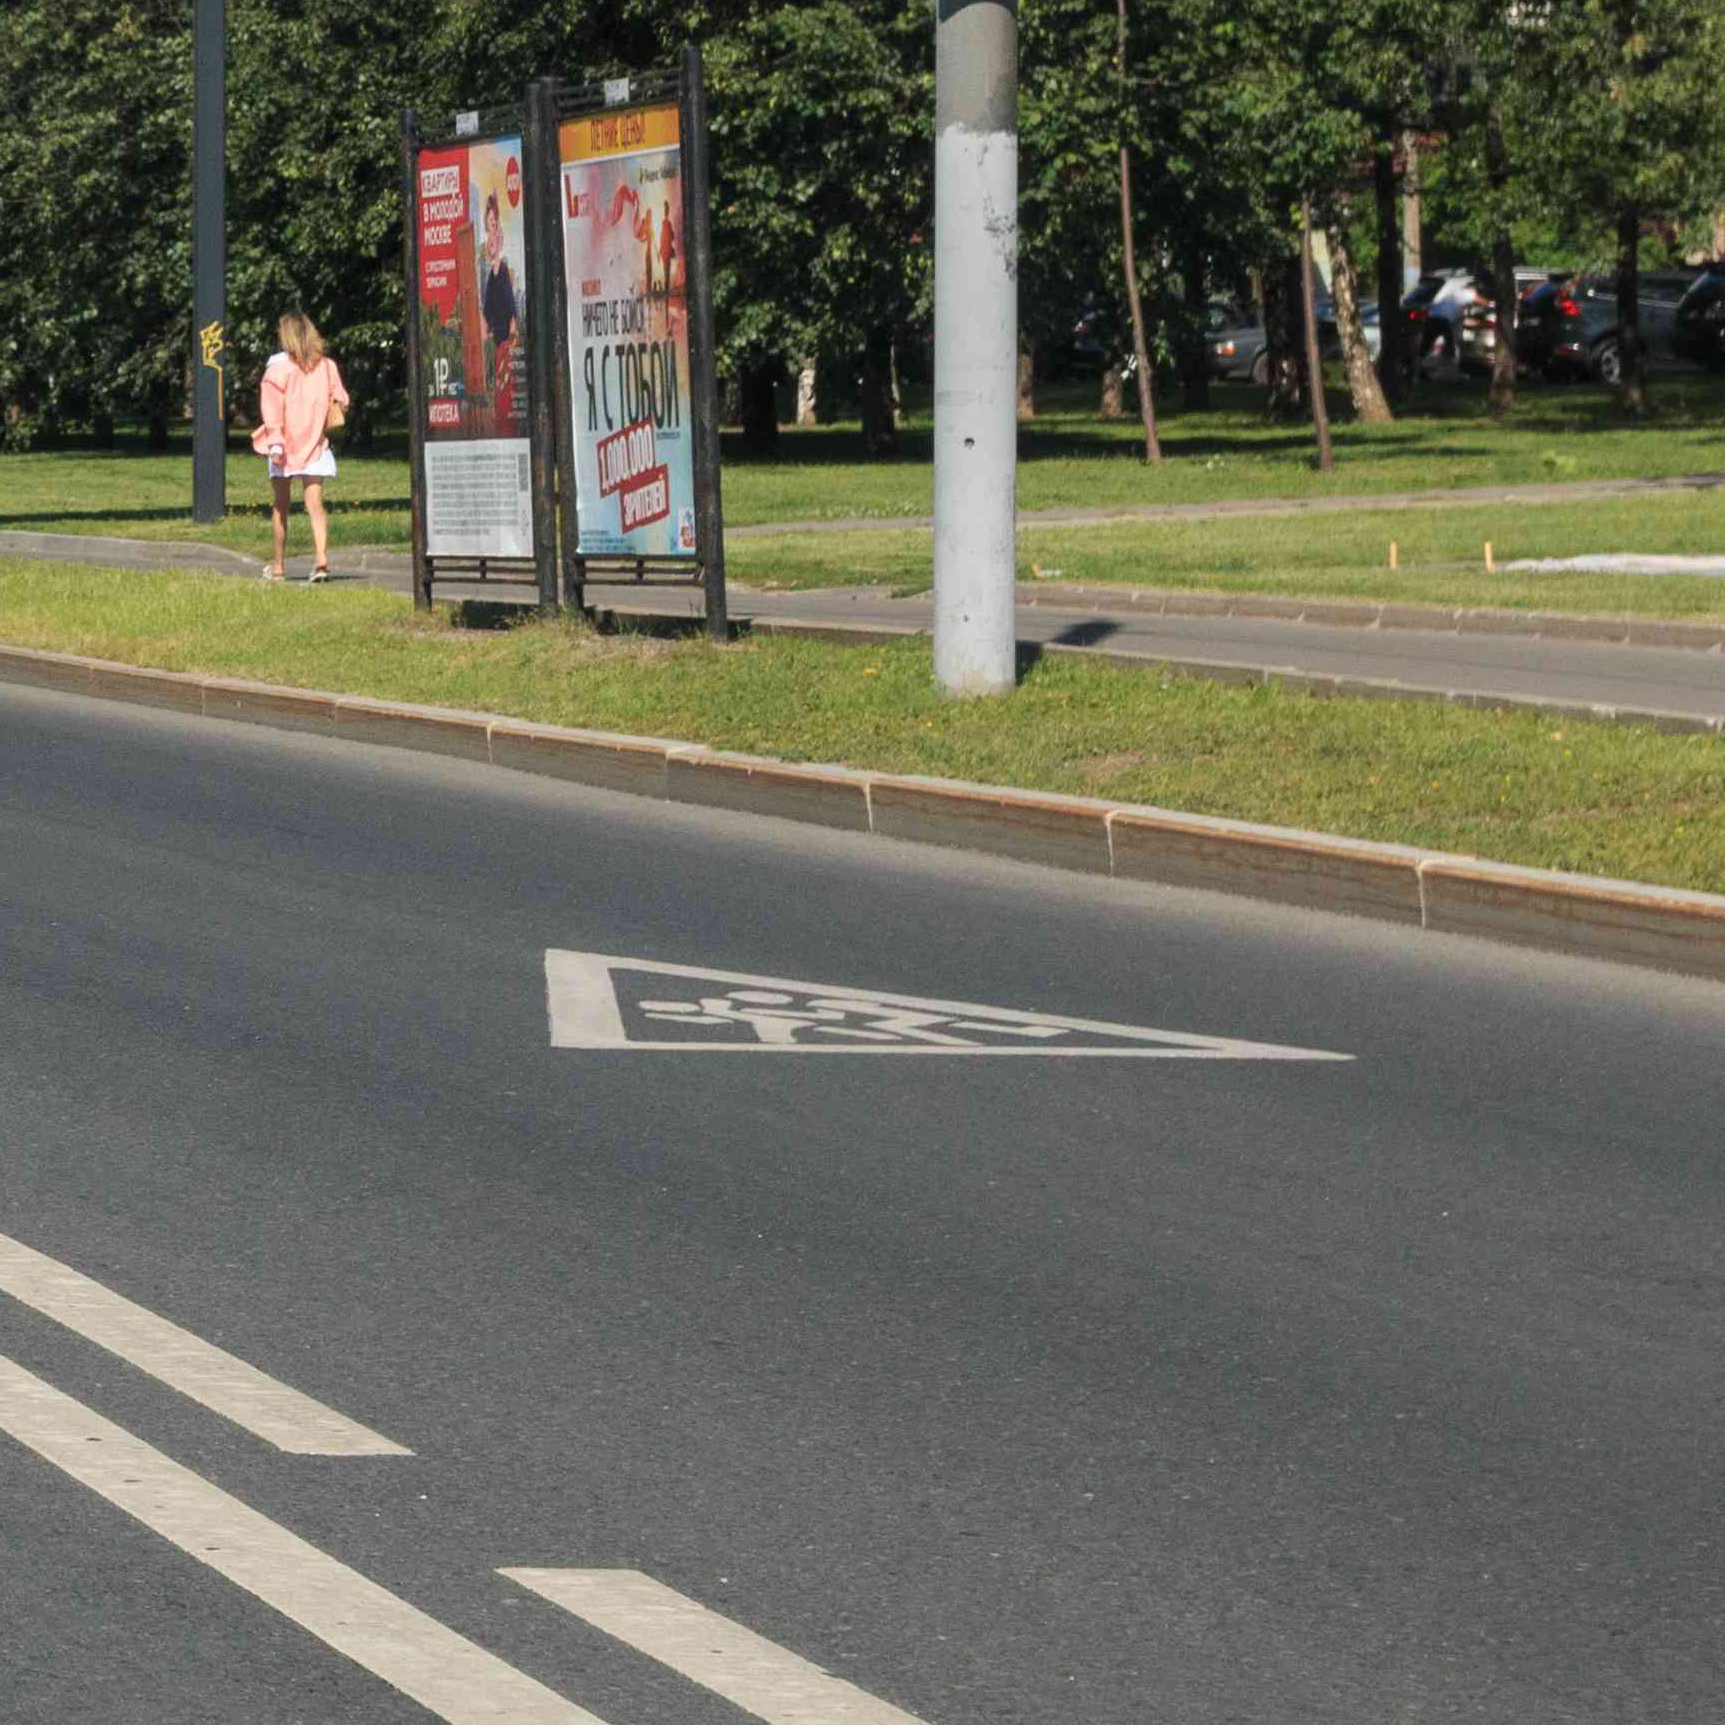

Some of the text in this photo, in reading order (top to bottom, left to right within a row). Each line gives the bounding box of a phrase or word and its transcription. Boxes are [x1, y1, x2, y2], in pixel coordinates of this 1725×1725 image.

[584, 345, 598, 432] Я
[602, 344, 614, 432] С
[615, 339, 680, 429] ТОБОЙ
